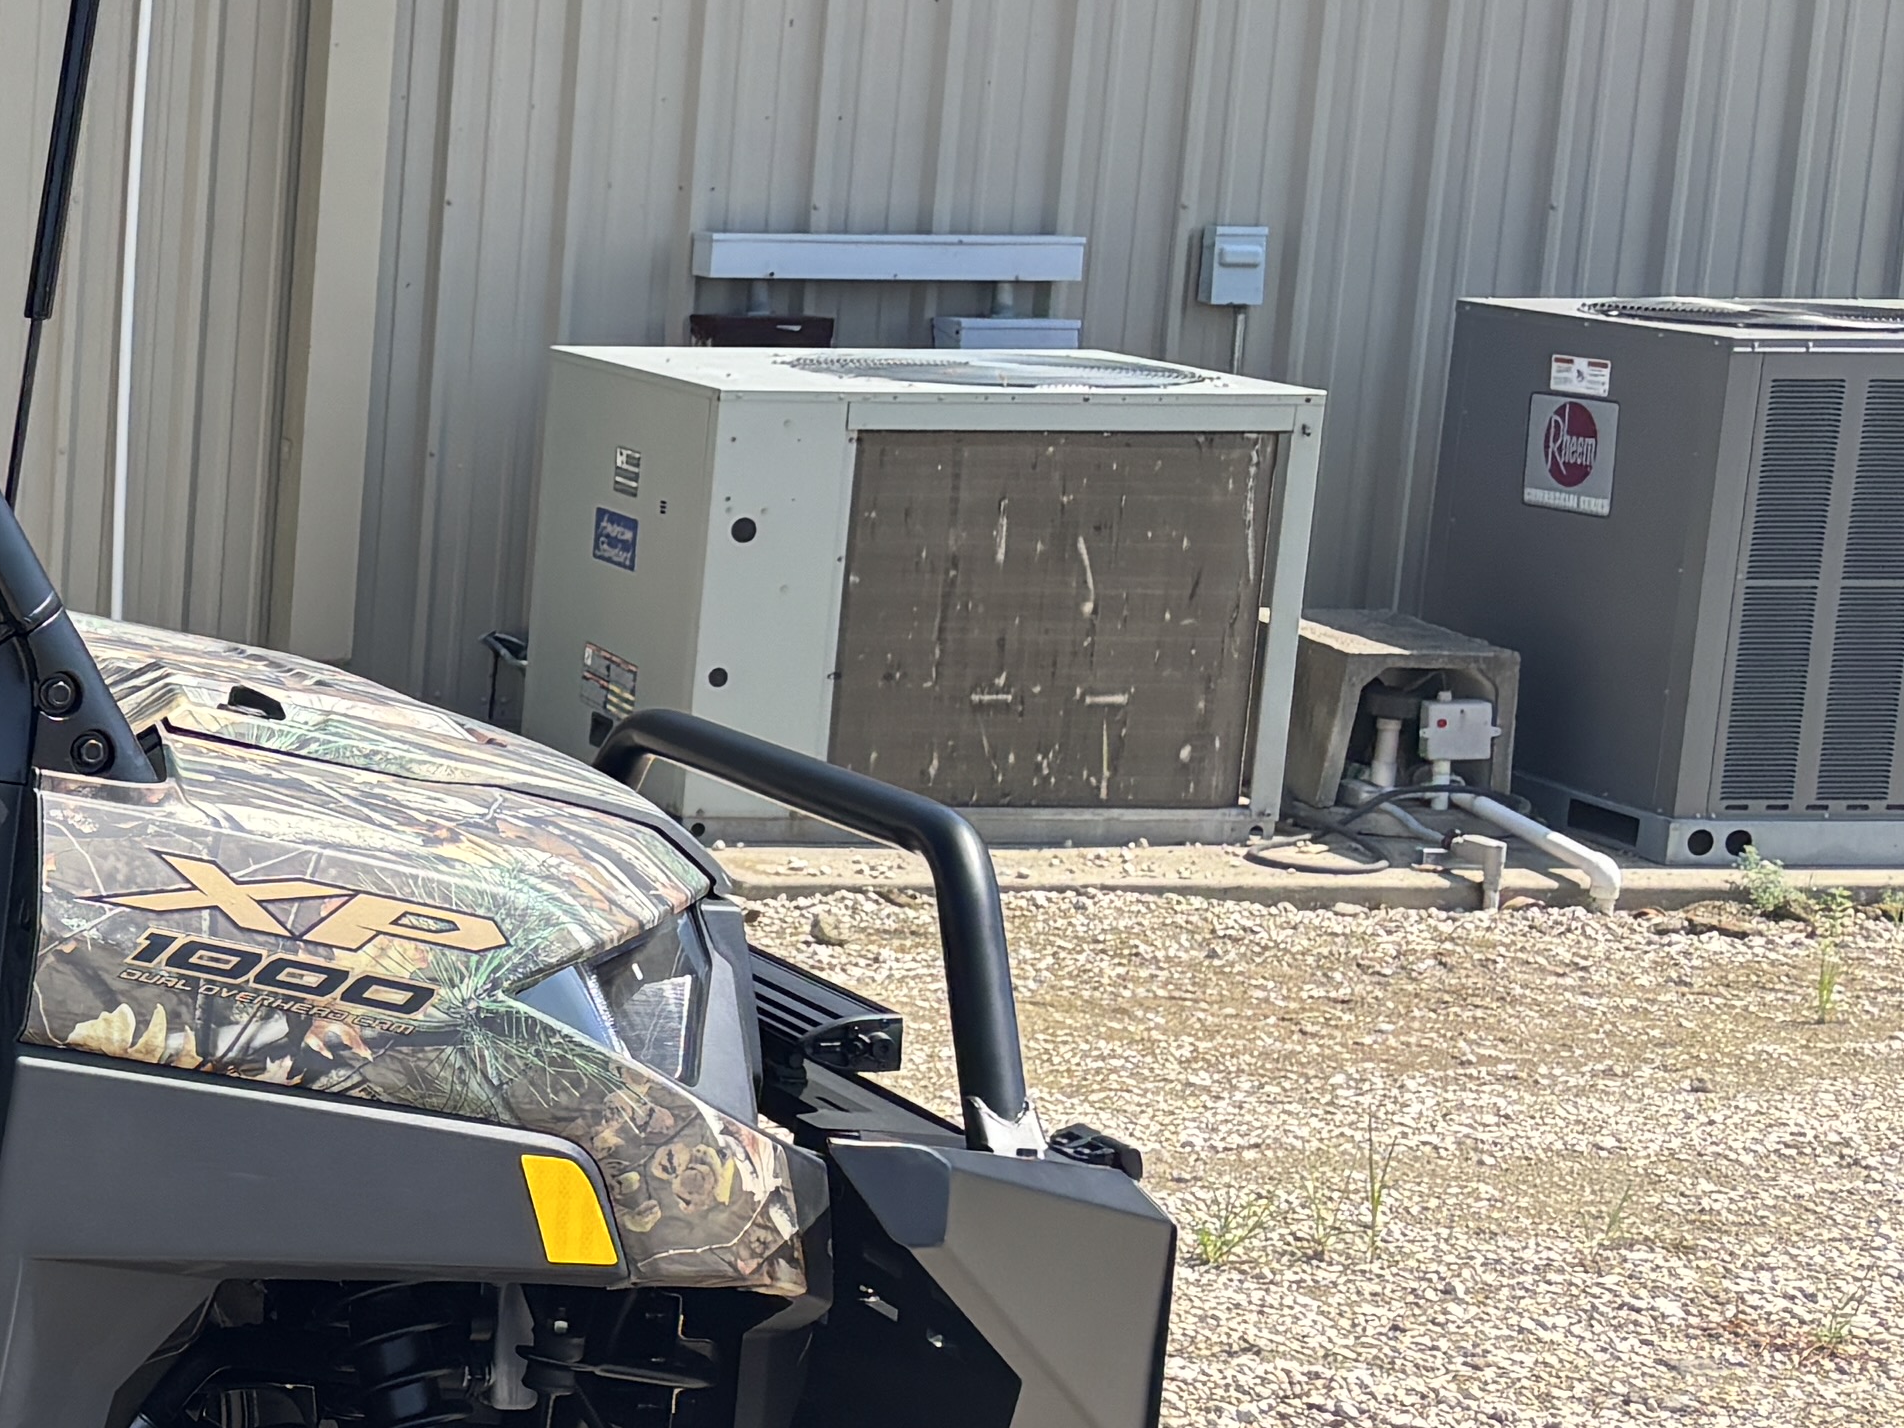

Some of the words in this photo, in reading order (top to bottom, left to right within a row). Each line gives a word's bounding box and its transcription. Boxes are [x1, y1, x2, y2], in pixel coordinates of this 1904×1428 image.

[1547, 402, 1595, 475] Rheem
[74, 848, 510, 952] XP
[117, 968, 192, 992] DUAL
[196, 983, 349, 1022] OVERHEAD
[351, 1014, 418, 1036] CAM
[123, 927, 439, 1020] 1000
